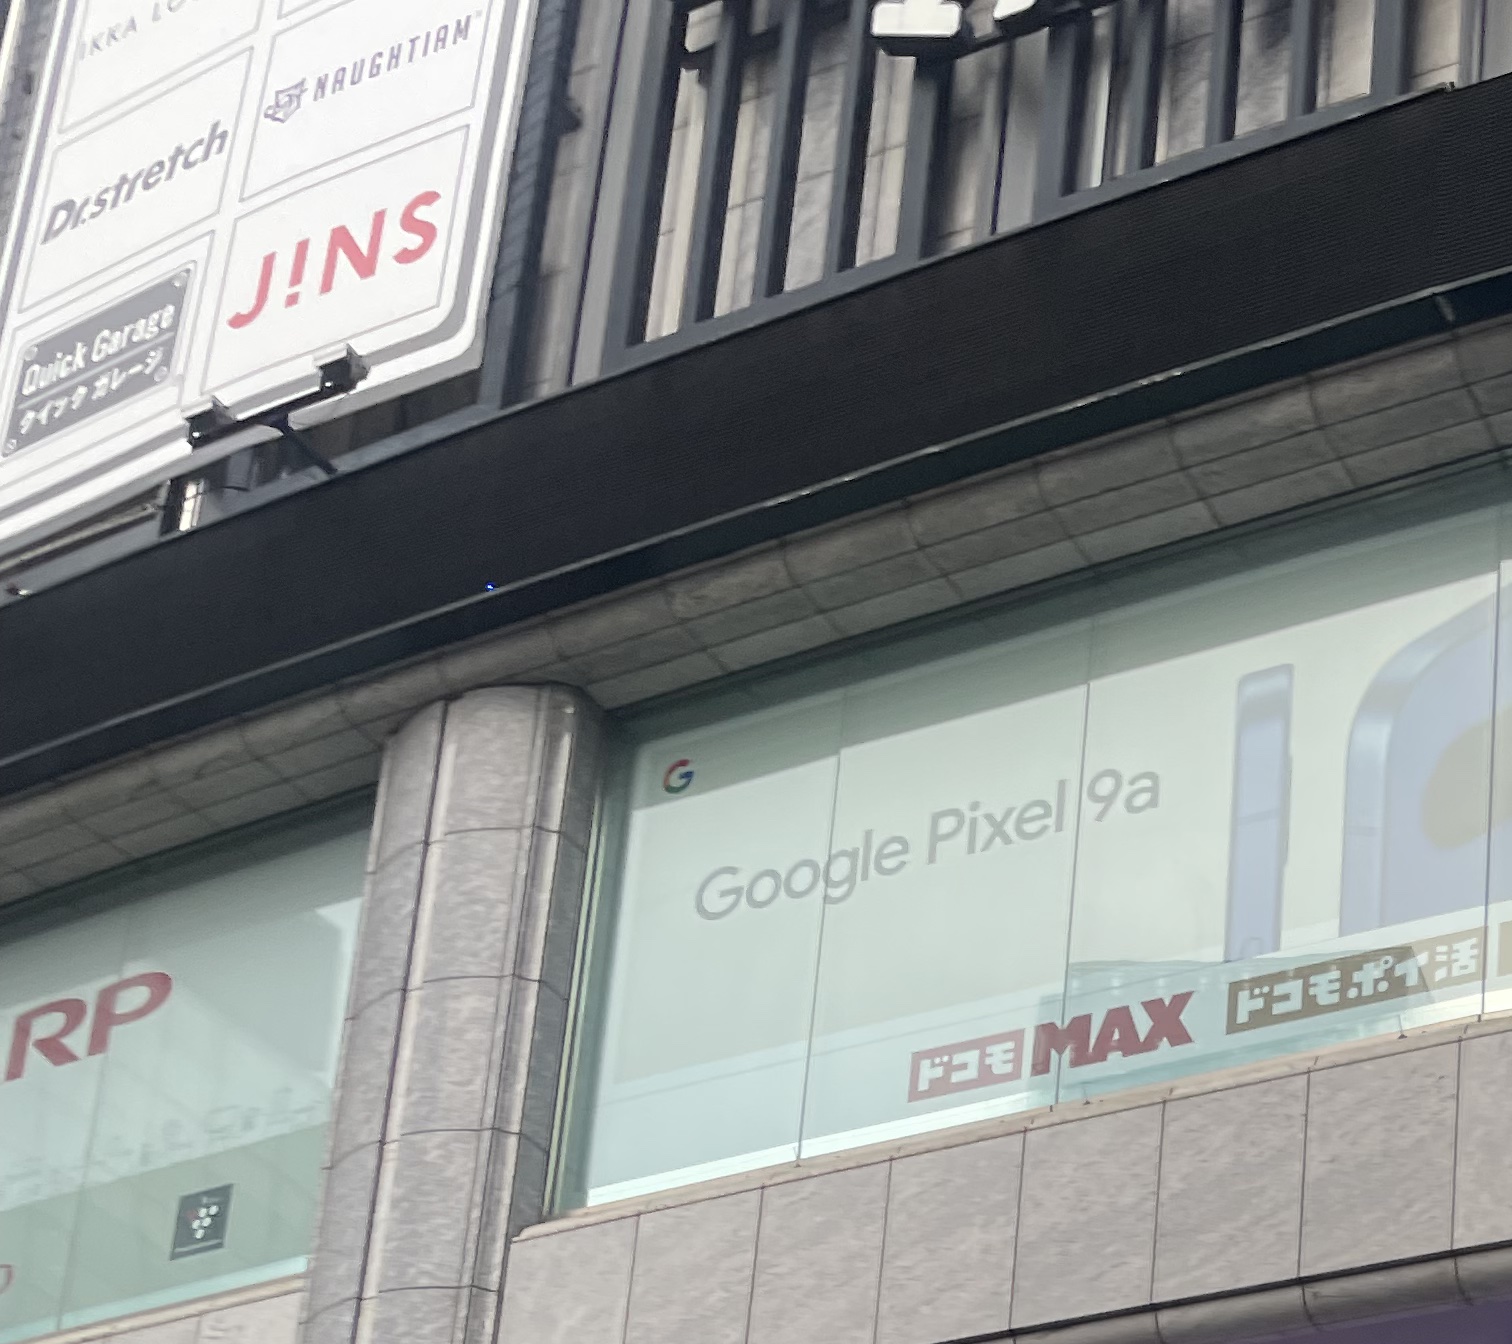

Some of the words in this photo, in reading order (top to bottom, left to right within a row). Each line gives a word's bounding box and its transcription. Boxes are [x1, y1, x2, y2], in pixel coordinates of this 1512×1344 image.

[22, 341, 88, 396] Quick
[92, 303, 175, 362] Garage
[695, 830, 910, 921] Google
[926, 778, 1069, 865] Pixel
[1086, 768, 1161, 822] 9a
[1235, 938, 1481, 1024] ドコモポイ活
[917, 1042, 1018, 1092] ドコモ
[1029, 990, 1195, 1077] MAX
